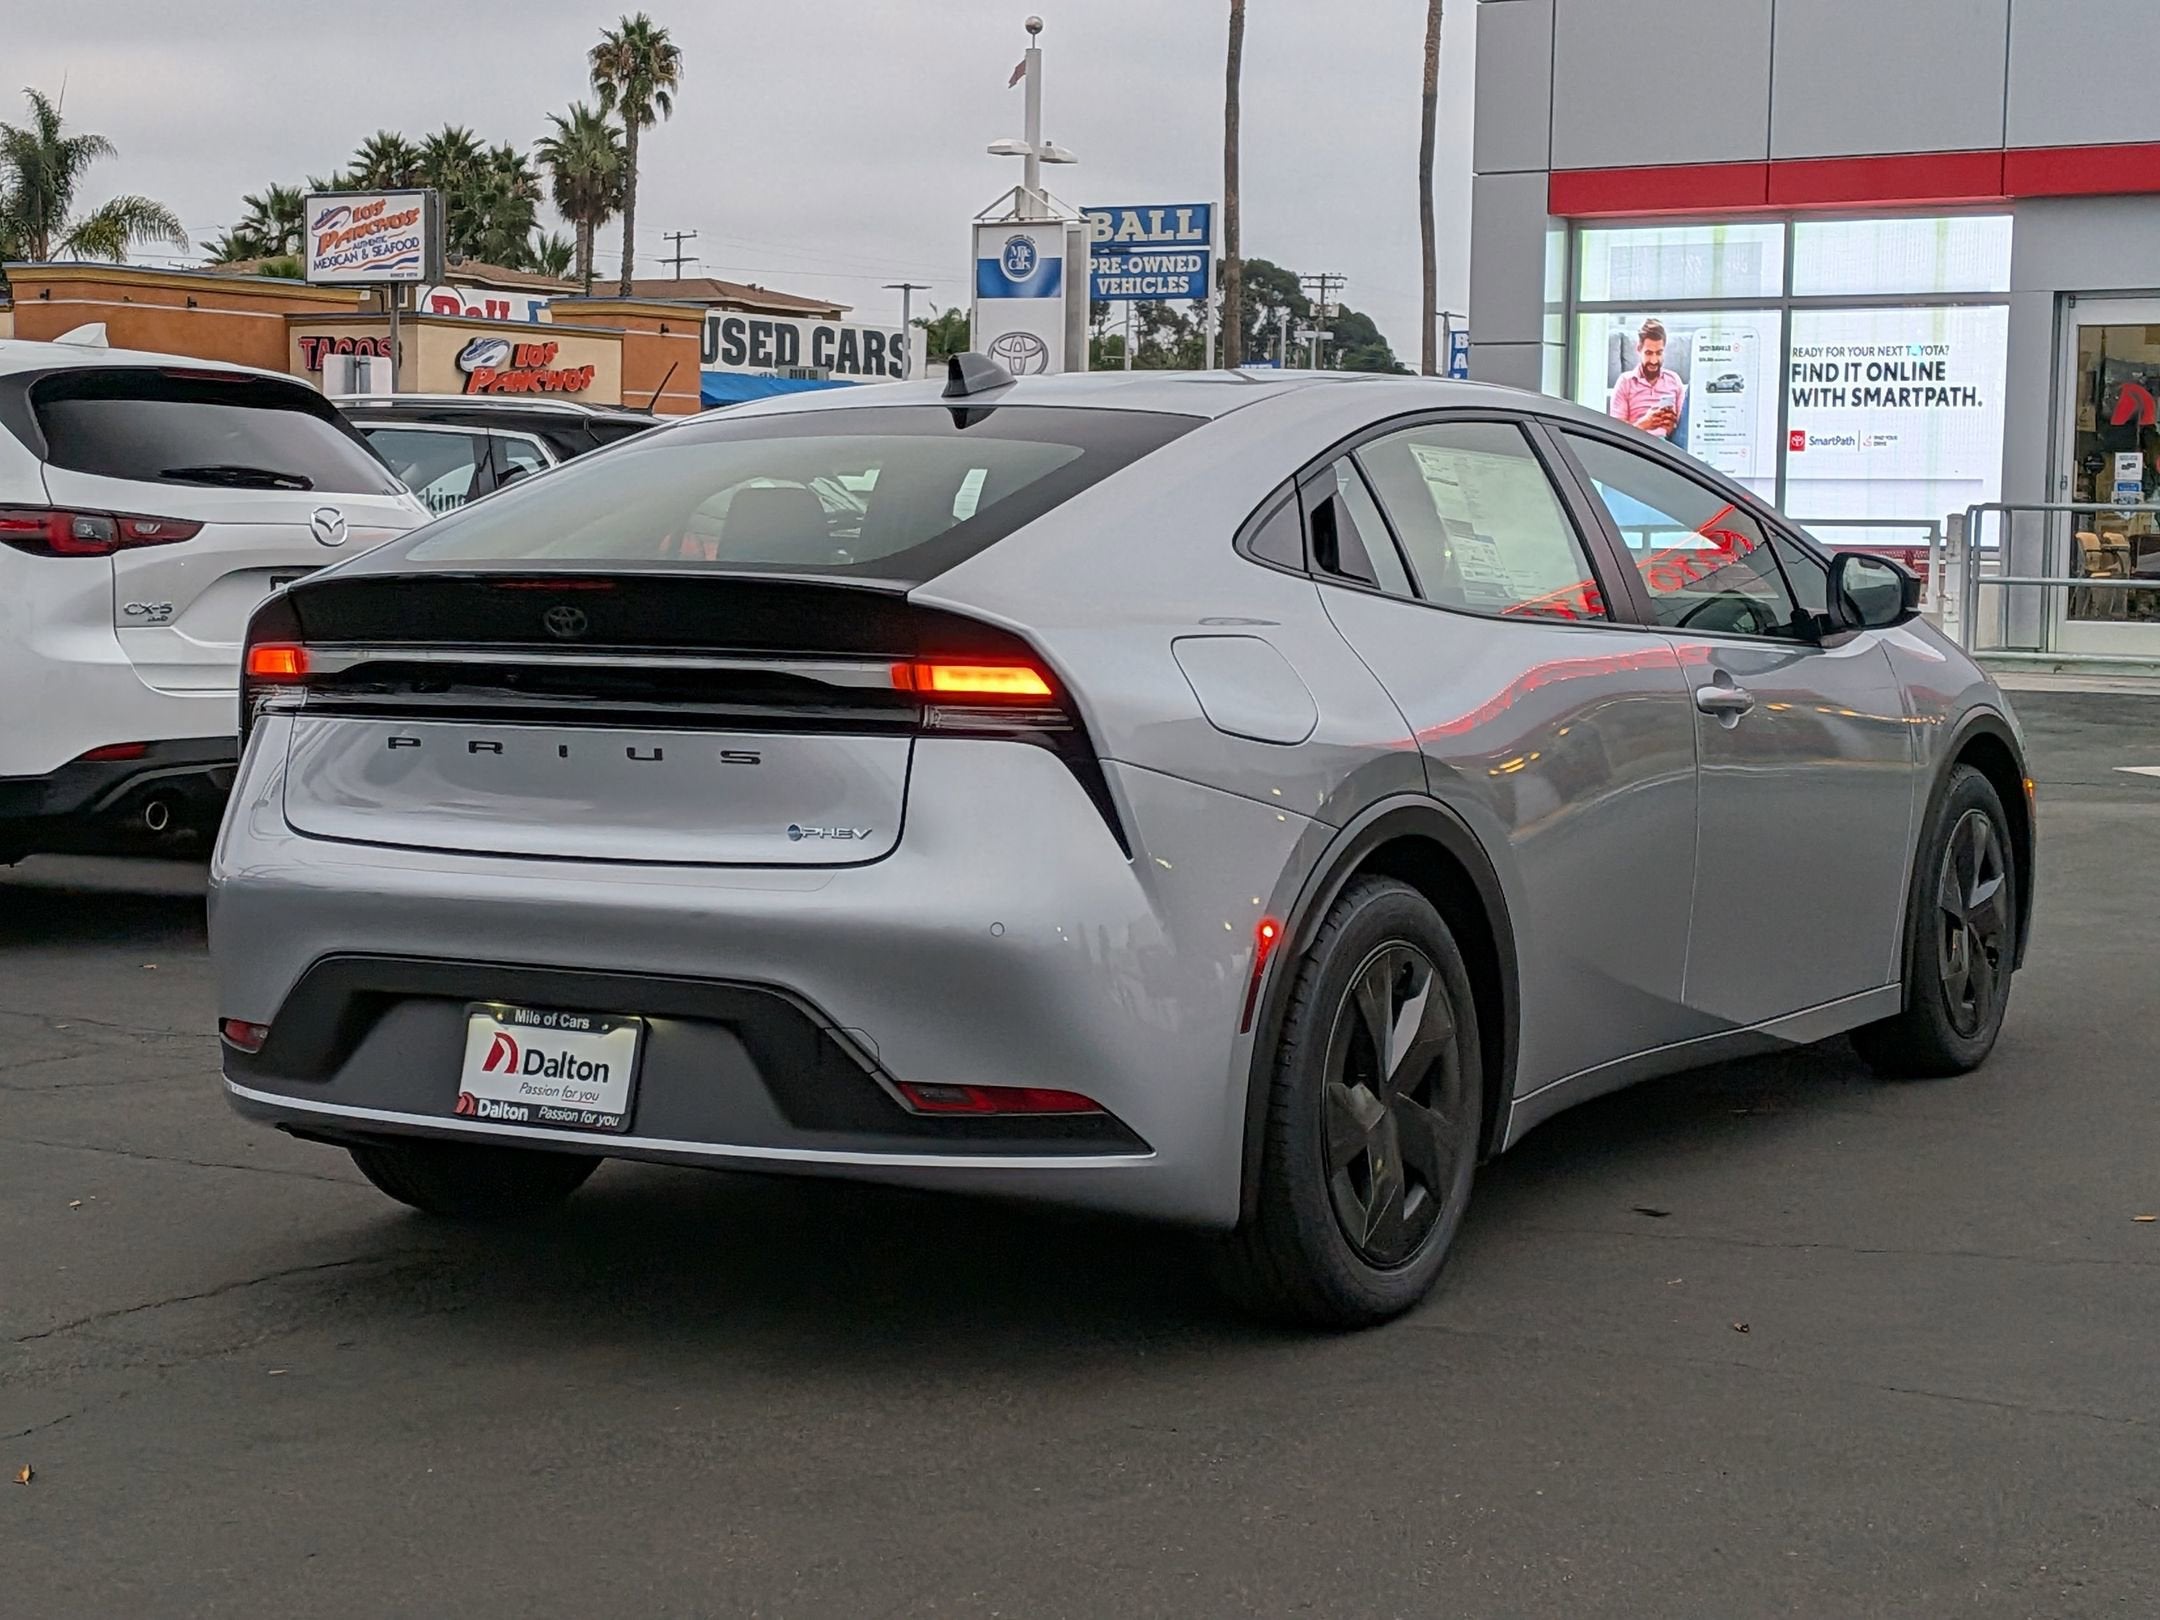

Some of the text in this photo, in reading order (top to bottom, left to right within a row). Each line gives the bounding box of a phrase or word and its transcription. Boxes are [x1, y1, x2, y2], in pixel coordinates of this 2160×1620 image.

[353, 199, 386, 223] LOS
[316, 208, 420, 257] PANCHOS
[1088, 209, 1202, 242] BALL
[313, 237, 419, 271] MEXICAN & SEAFOOD
[1089, 255, 1201, 274] PRE-OWNED
[1097, 276, 1190, 294] VEHICLES
[298, 336, 393, 370] TACOS
[515, 341, 559, 368] LOS
[701, 317, 800, 368] USED
[812, 326, 911, 379] CARS
[1454, 333, 1470, 379] BA
[1792, 346, 1823, 357] READY
[1826, 346, 1846, 357] FOR
[1847, 346, 1875, 357] YOUR
[1877, 346, 1904, 356] NEXT
[467, 365, 595, 394] PANCHOS
[1792, 361, 1946, 382] FIND IT ONLINE
[1792, 386, 1983, 407] WITH SMARTPATH.
[1808, 435, 1856, 447] SmartPath
[124, 602, 173, 615] CX-5
[388, 737, 761, 765] PRIUS
[802, 827, 873, 840] PHEV
[515, 1009, 589, 1029] Mile of Cars
[523, 1049, 610, 1083] Dalton
[519, 1082, 600, 1102] Passion for you
[477, 1100, 620, 1127] Dalton Passion for you
